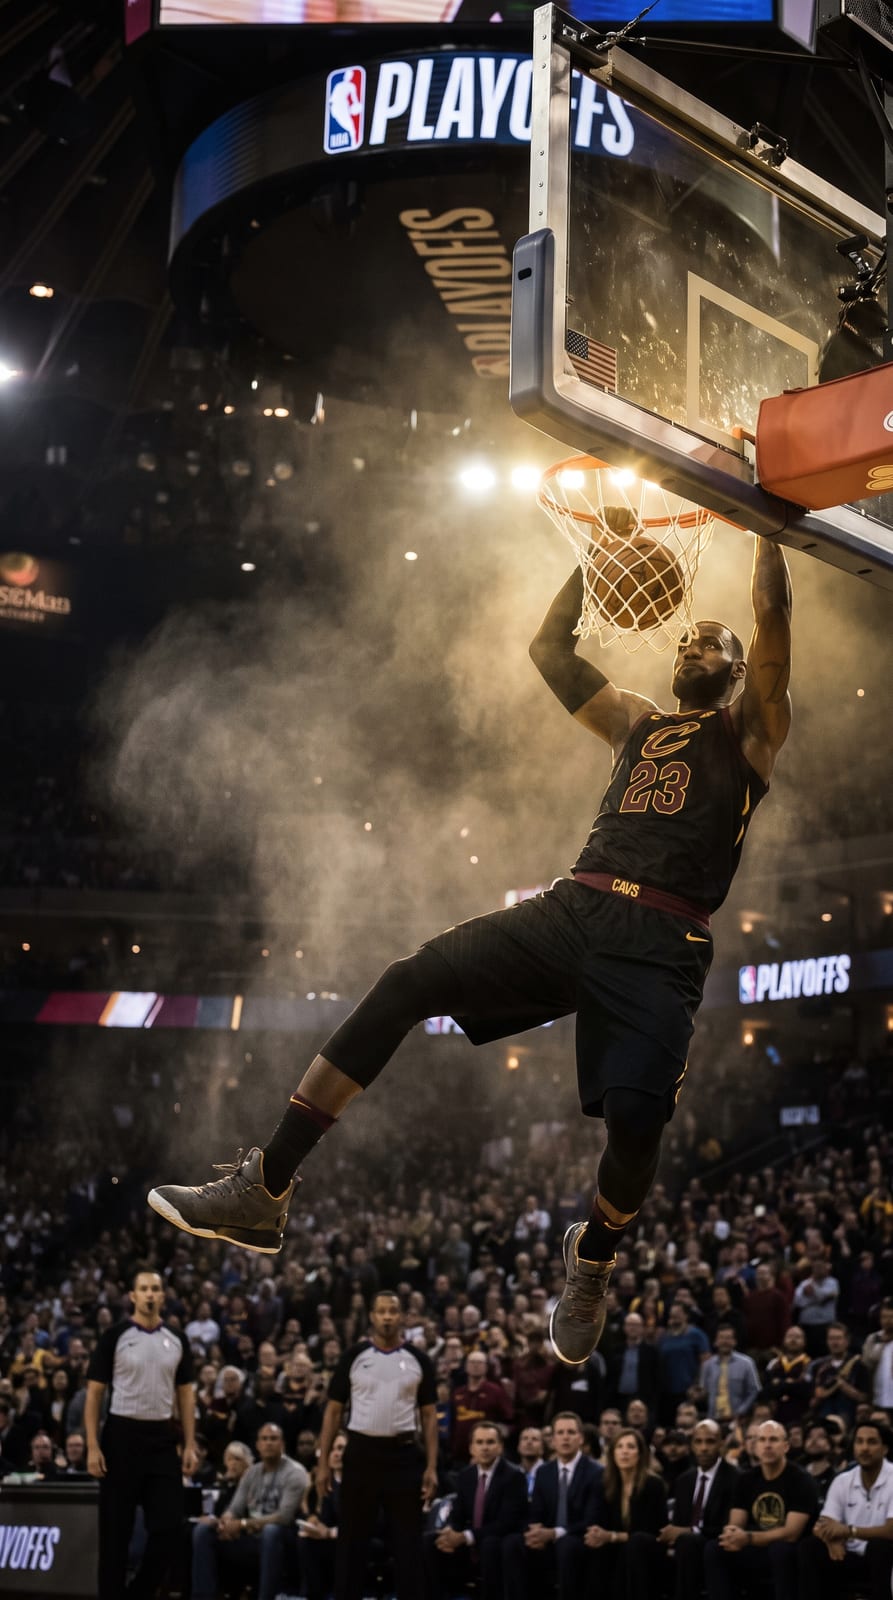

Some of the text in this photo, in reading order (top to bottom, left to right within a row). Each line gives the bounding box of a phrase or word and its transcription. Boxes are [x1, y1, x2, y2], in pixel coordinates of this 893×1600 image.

[369, 57, 635, 156] PLAYOFS
[619, 760, 691, 815] 23
[611, 878, 640, 898] CAVS
[755, 954, 851, 1002] PLAYOFFS
[0, 1525, 61, 1571] YOFFS
